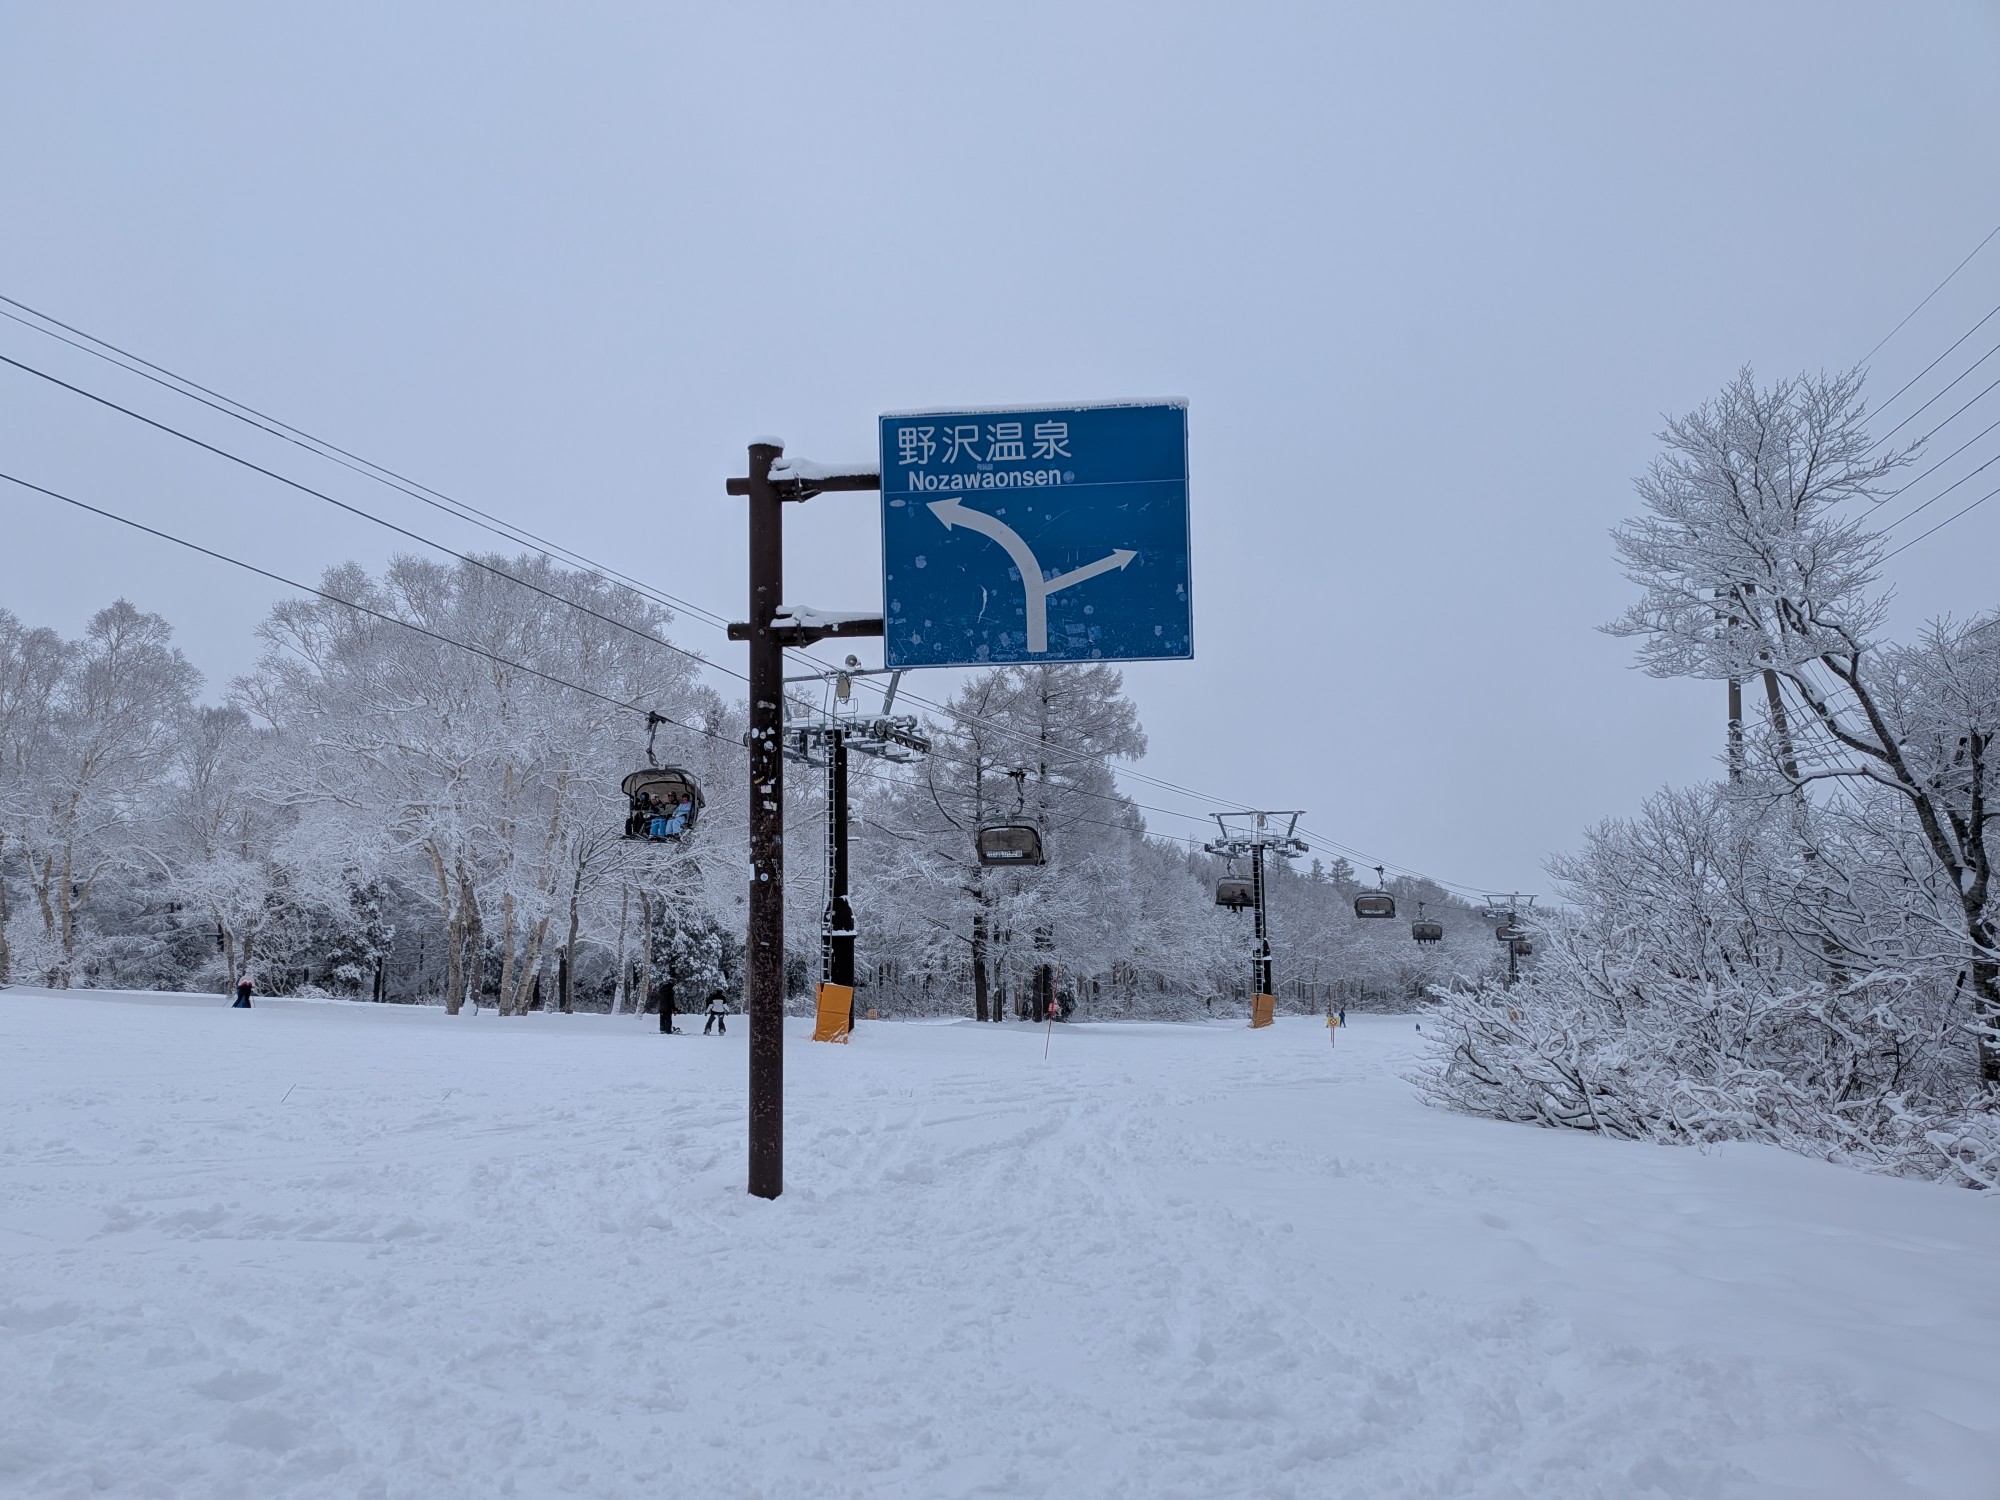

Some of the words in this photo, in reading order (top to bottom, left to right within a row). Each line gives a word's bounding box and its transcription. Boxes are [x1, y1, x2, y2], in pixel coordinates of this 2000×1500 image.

[898, 420, 1072, 465] 野沢温泉
[908, 469, 1061, 491] Nozawaonsen
